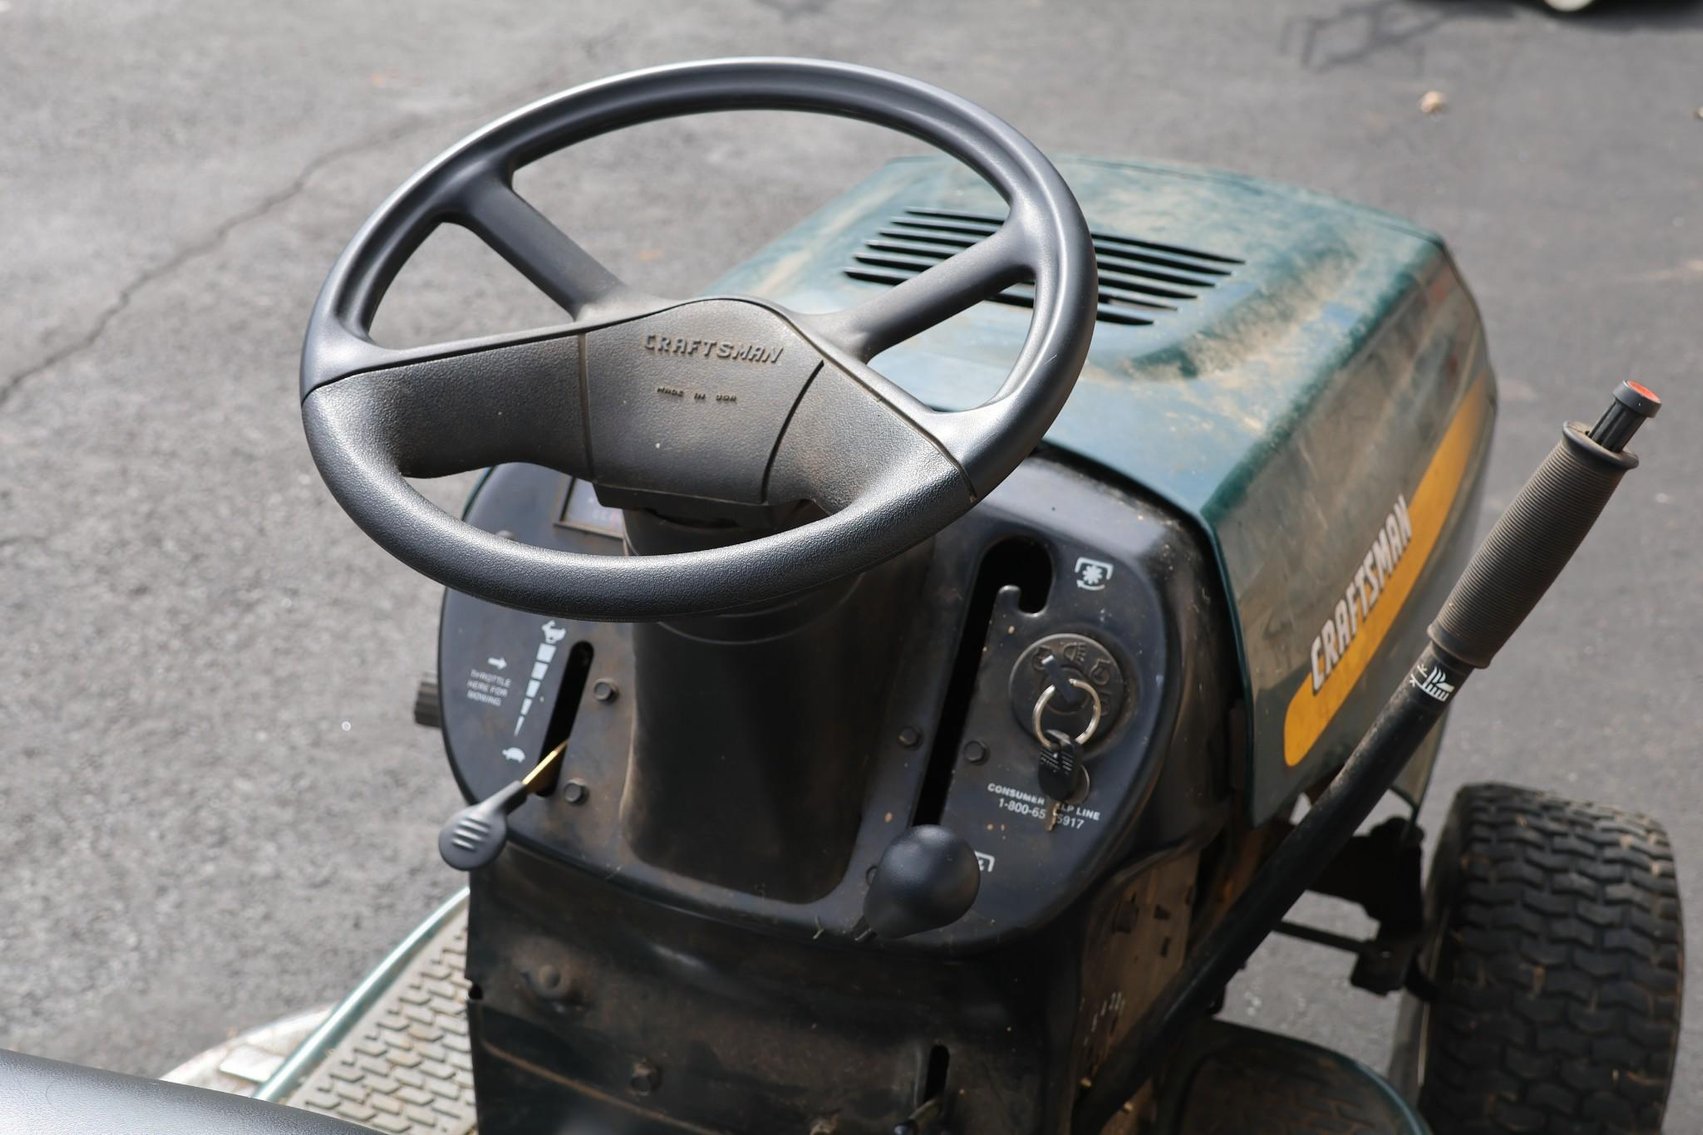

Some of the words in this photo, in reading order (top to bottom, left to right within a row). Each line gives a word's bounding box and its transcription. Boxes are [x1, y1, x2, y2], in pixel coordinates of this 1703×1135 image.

[644, 335, 784, 363] CRAFTSMAN
[1311, 494, 1412, 694] CRAFTSMAN
[987, 783, 1045, 805] CONSUMER
[1076, 807, 1100, 820] LINE
